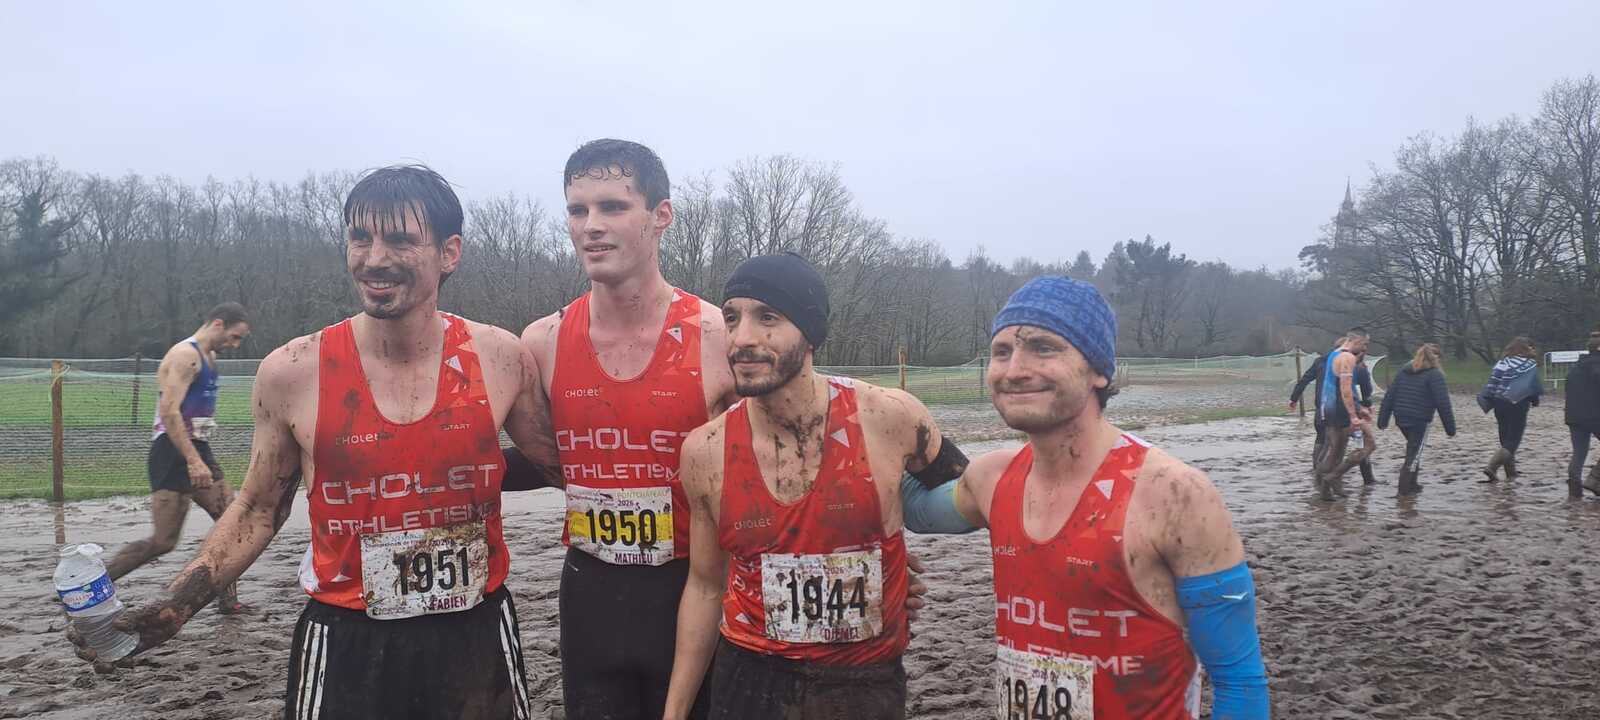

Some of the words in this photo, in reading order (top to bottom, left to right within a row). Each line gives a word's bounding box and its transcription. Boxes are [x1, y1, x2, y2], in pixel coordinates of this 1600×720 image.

[321, 463, 498, 505] CHOLET
[563, 463, 682, 481] ATHLETISM
[586, 509, 657, 547] 1950
[396, 547, 470, 596] 1951
[614, 553, 653, 565] MATHIEU
[432, 595, 467, 610] FABIEN
[787, 572, 868, 625] 1944
[995, 594, 1138, 638] HOLET
[1003, 677, 1073, 720] 1948
